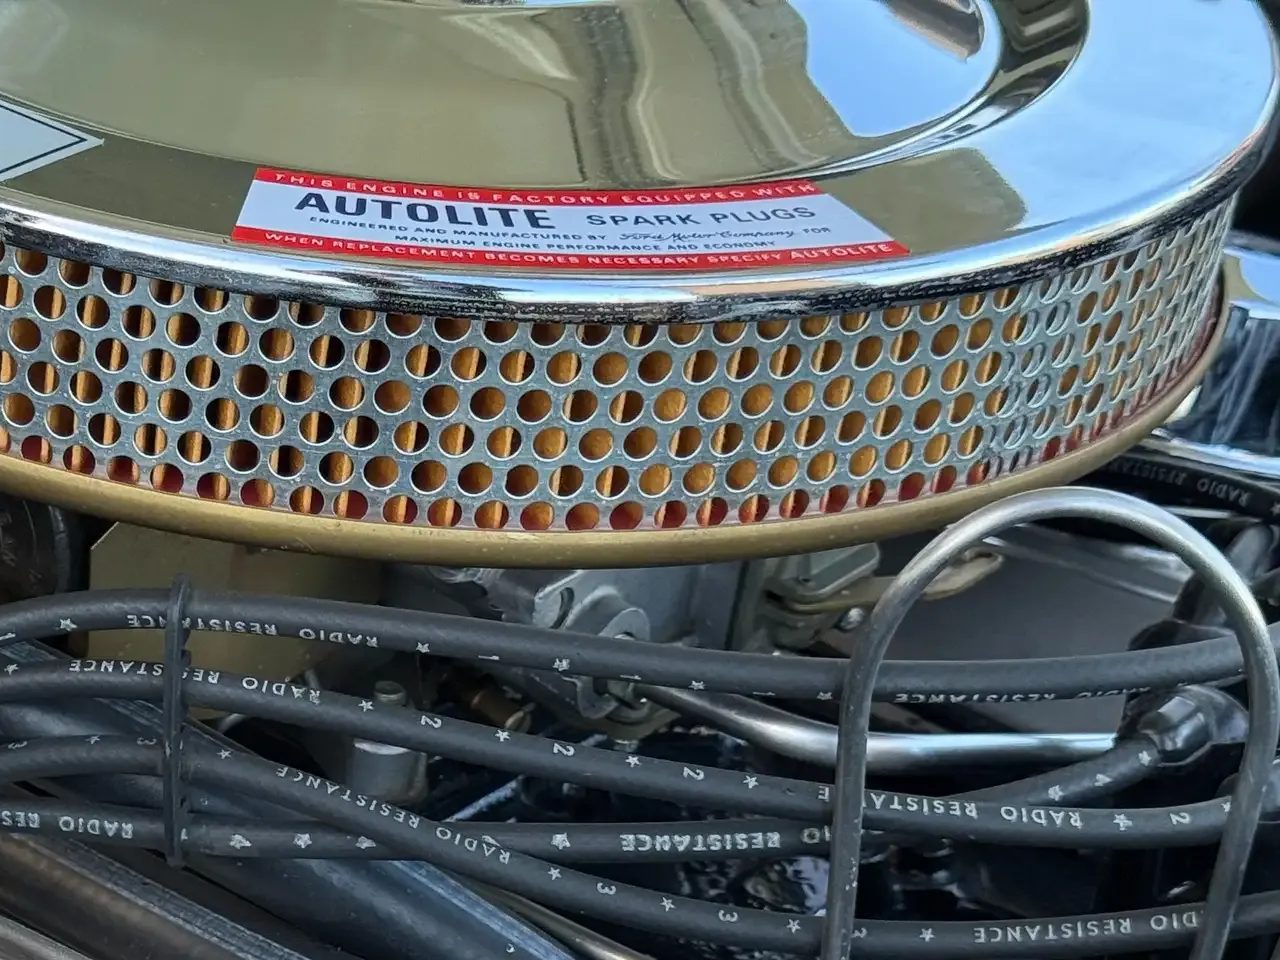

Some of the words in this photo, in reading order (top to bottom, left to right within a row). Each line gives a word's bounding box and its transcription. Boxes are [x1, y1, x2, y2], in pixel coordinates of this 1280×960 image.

[274, 173, 334, 187] THIS
[346, 182, 443, 197] ENGINE
[457, 191, 481, 200] IS
[492, 194, 609, 204] FACTORY
[621, 190, 746, 204] EQUIPPED
[752, 183, 816, 198] WITH
[294, 192, 556, 230] AUTOLITE
[586, 213, 702, 226] SPARK
[709, 206, 817, 224] PLUGS
[309, 216, 408, 232] ENGINEERED
[414, 226, 447, 235] AND
[453, 229, 582, 241] MANUFACTURED
[802, 227, 832, 235] FOR
[395, 234, 476, 246] MAXIMUM
[483, 240, 540, 249] ENGINE
[547, 243, 661, 251] PERFORMANCE
[704, 241, 776, 249] ECONOMY
[265, 232, 324, 246] WHEN
[332, 241, 476, 260] REPLACEMENT
[485, 253, 579, 264] BECOMES
[587, 256, 700, 265] NECESSARY
[707, 252, 782, 263] SPECIFY
[790, 244, 893, 260] AUTOLITE
[1196, 477, 1251, 508] RADIO
[299, 628, 378, 648] RADIO
[241, 676, 321, 705] RADIO
[275, 766, 420, 829] RESISTANCE
[58, 815, 134, 840] RADIO
[1000, 805, 1082, 830] RADIO
[436, 826, 512, 864] RADIO
[620, 831, 781, 852] RESISTANCE
[973, 917, 1133, 944] RESISTANCE
